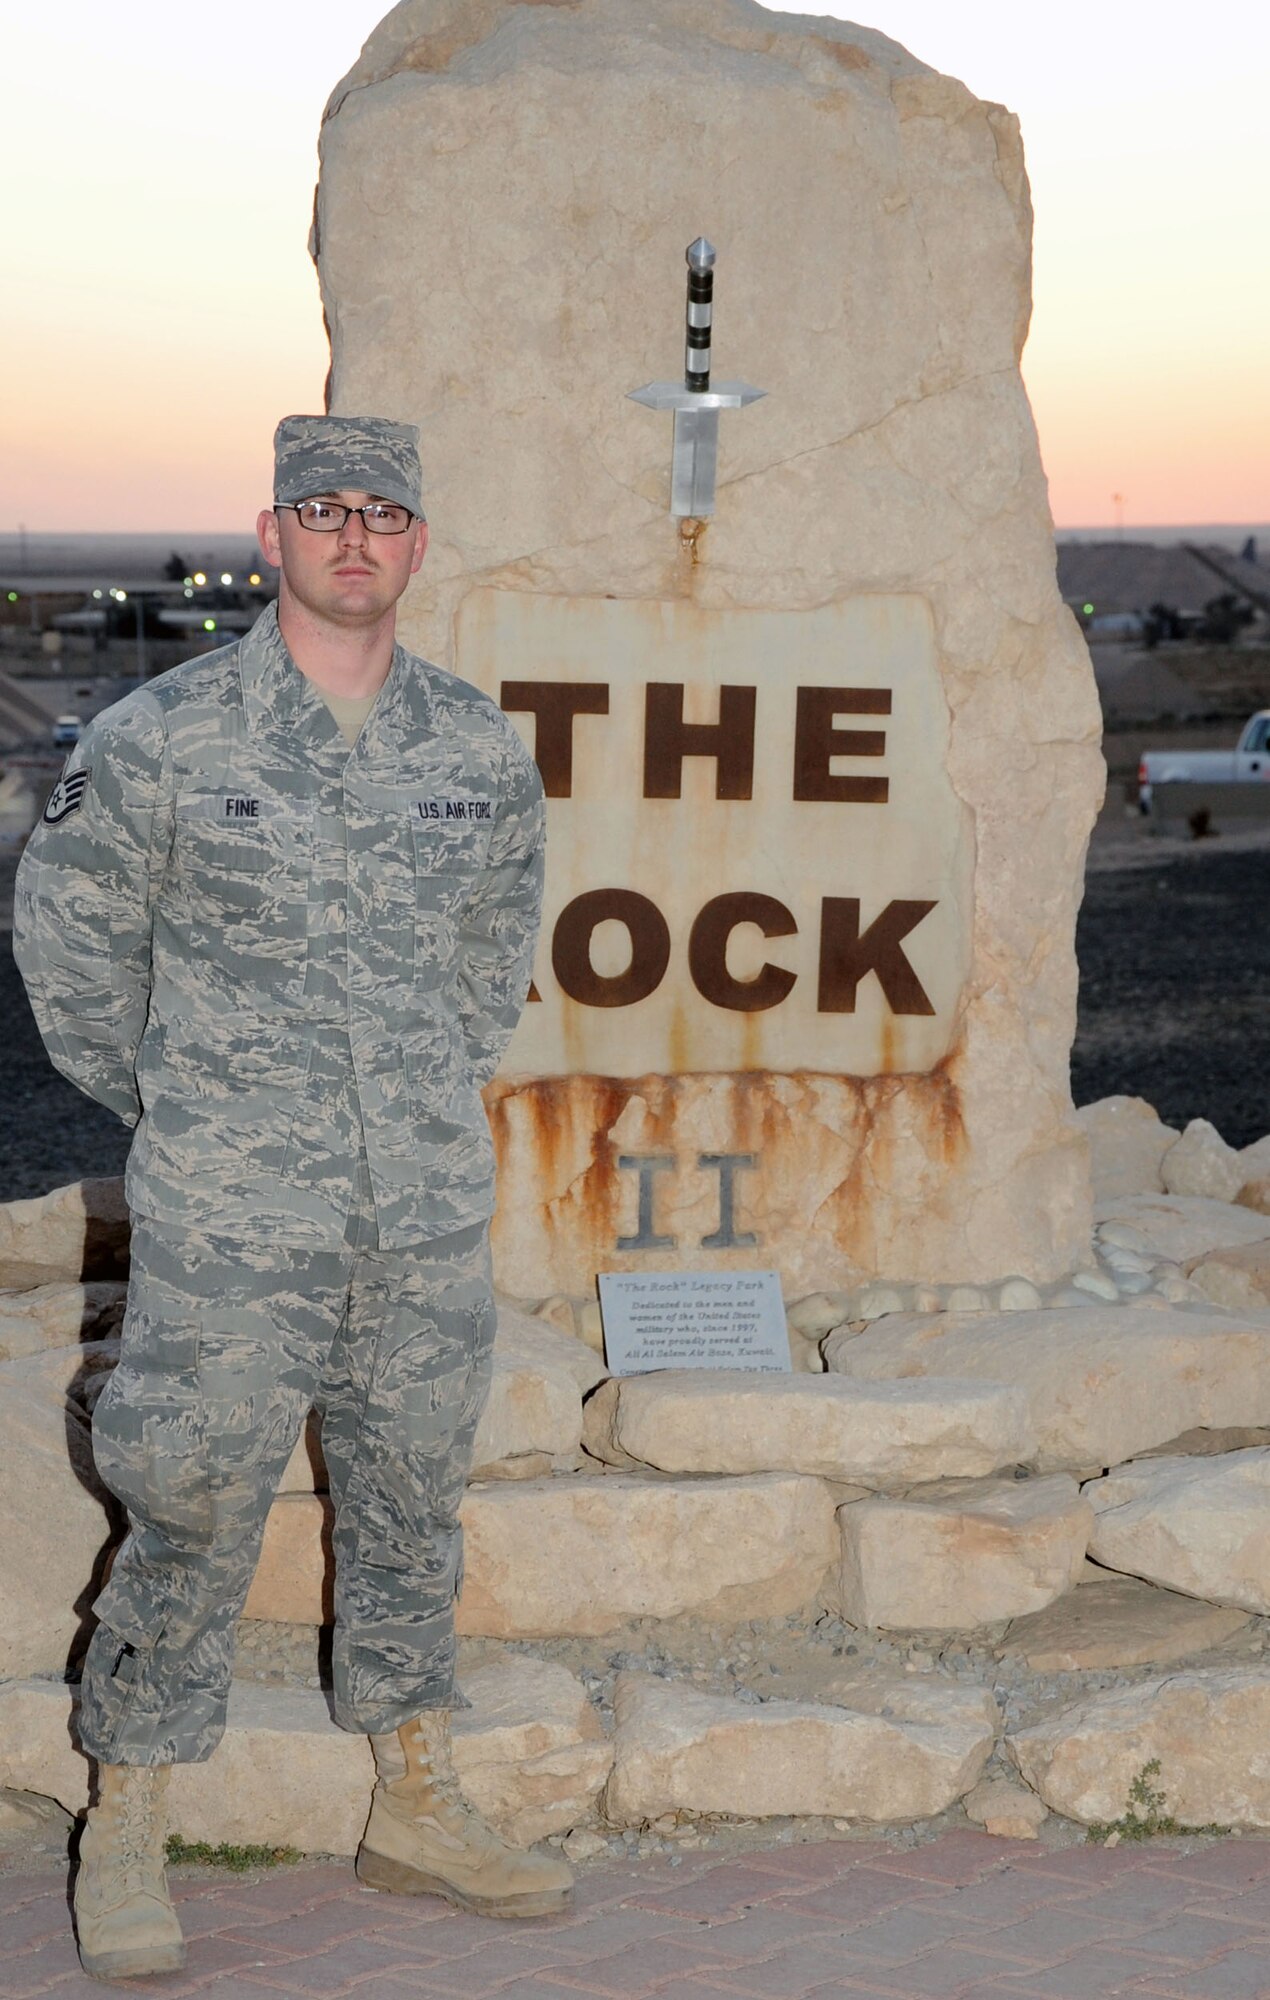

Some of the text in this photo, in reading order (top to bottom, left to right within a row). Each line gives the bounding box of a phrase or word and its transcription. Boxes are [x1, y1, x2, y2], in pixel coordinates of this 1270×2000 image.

[500, 681, 892, 803] THE
[225, 798, 260, 817] FINE
[418, 801, 443, 819] U.S.
[446, 801, 467, 819] AIR
[526, 887, 940, 1016] OCK
[691, 1280, 732, 1292] Legacy
[736, 1280, 764, 1290] Park
[632, 1301, 680, 1310] Dedicated
[666, 1312, 677, 1322] of
[698, 1311, 729, 1320] United
[732, 1311, 761, 1319] States
[636, 1326, 674, 1335] military
[677, 1325, 700, 1334] who,
[668, 1336, 706, 1346] proudly
[709, 1336, 740, 1344] served
[656, 1349, 687, 1358] Salem
[688, 1349, 705, 1358] Air
